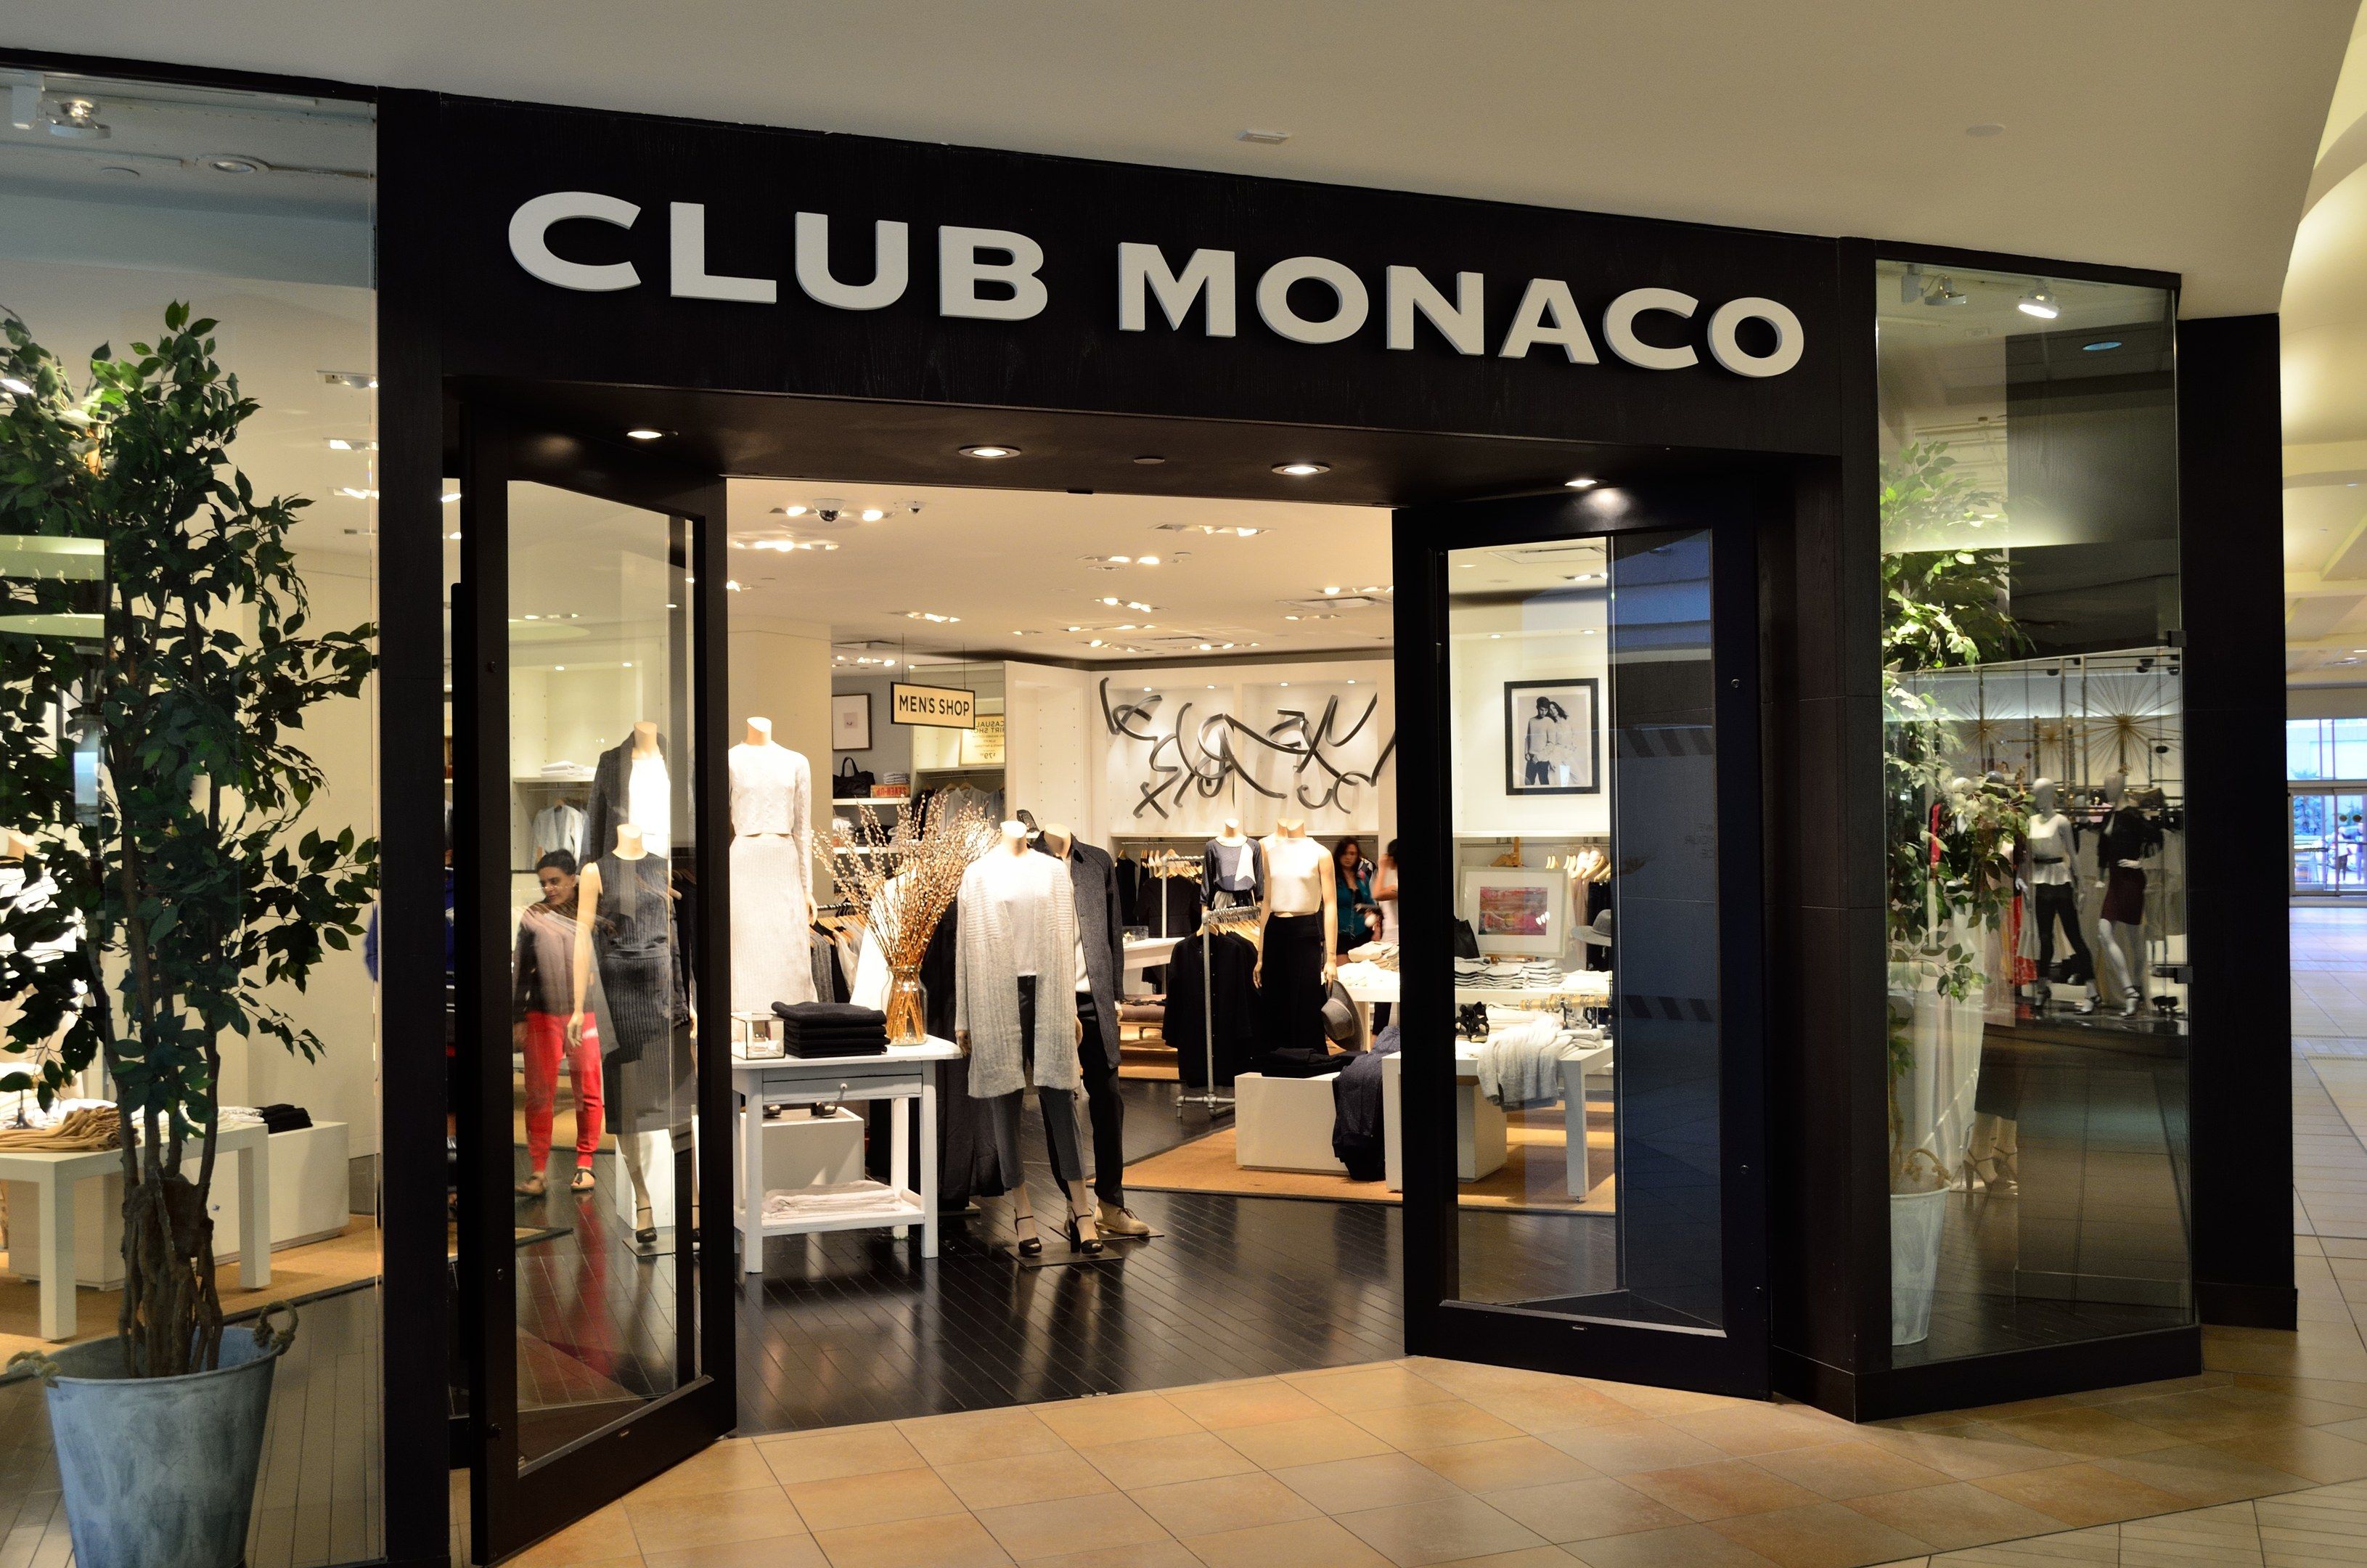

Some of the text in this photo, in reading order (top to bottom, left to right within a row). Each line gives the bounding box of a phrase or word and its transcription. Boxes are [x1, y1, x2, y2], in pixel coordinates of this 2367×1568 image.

[508, 191, 1804, 377] CLUB MONACO
[899, 695, 970, 716] MEN'S SHOP
